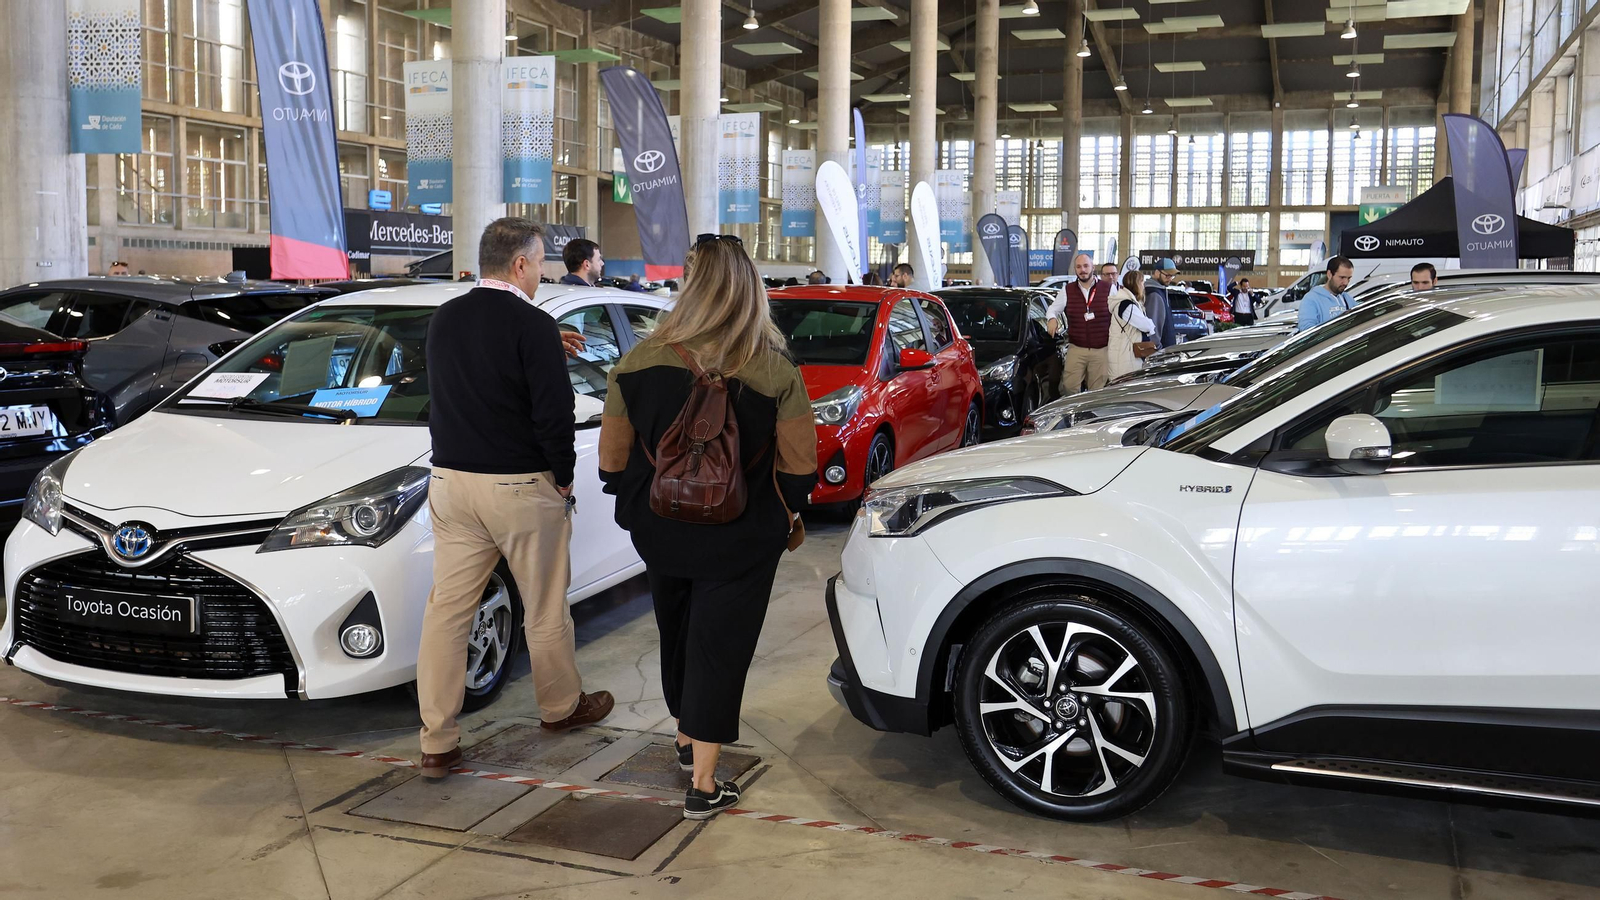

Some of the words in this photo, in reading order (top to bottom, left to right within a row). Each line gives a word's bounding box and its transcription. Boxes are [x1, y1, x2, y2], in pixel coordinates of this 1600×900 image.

[408, 71, 448, 84] IFECA
[507, 67, 549, 79] IFECA
[722, 121, 755, 131] IFECA
[369, 220, 453, 245] Mercedes-Ben
[1385, 238, 1424, 247] NIMAUTO
[1141, 255, 1153, 265] FIAT
[1225, 262, 1239, 270] Jeep
[314, 400, 343, 408] MOTOR
[343, 397, 379, 407] HÍBRIDO
[1179, 484, 1225, 493] HYBRID
[65, 594, 113, 616] Toyota
[117, 601, 181, 622] Ocasión
